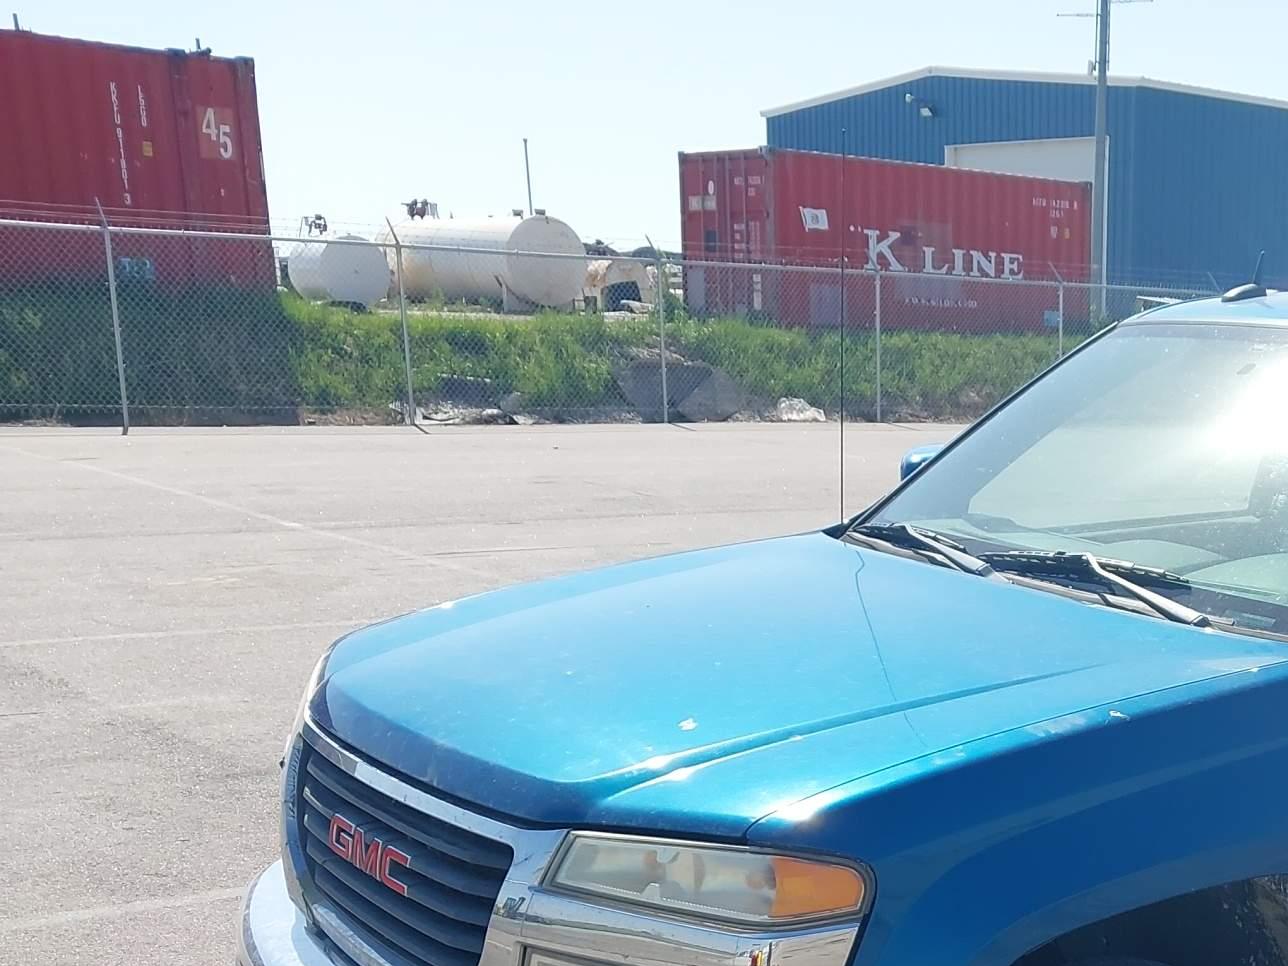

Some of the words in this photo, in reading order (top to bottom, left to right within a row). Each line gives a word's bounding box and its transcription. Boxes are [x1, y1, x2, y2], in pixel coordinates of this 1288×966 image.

[202, 107, 233, 159] 45
[922, 246, 1024, 281] LINE
[328, 813, 411, 896] GMC
